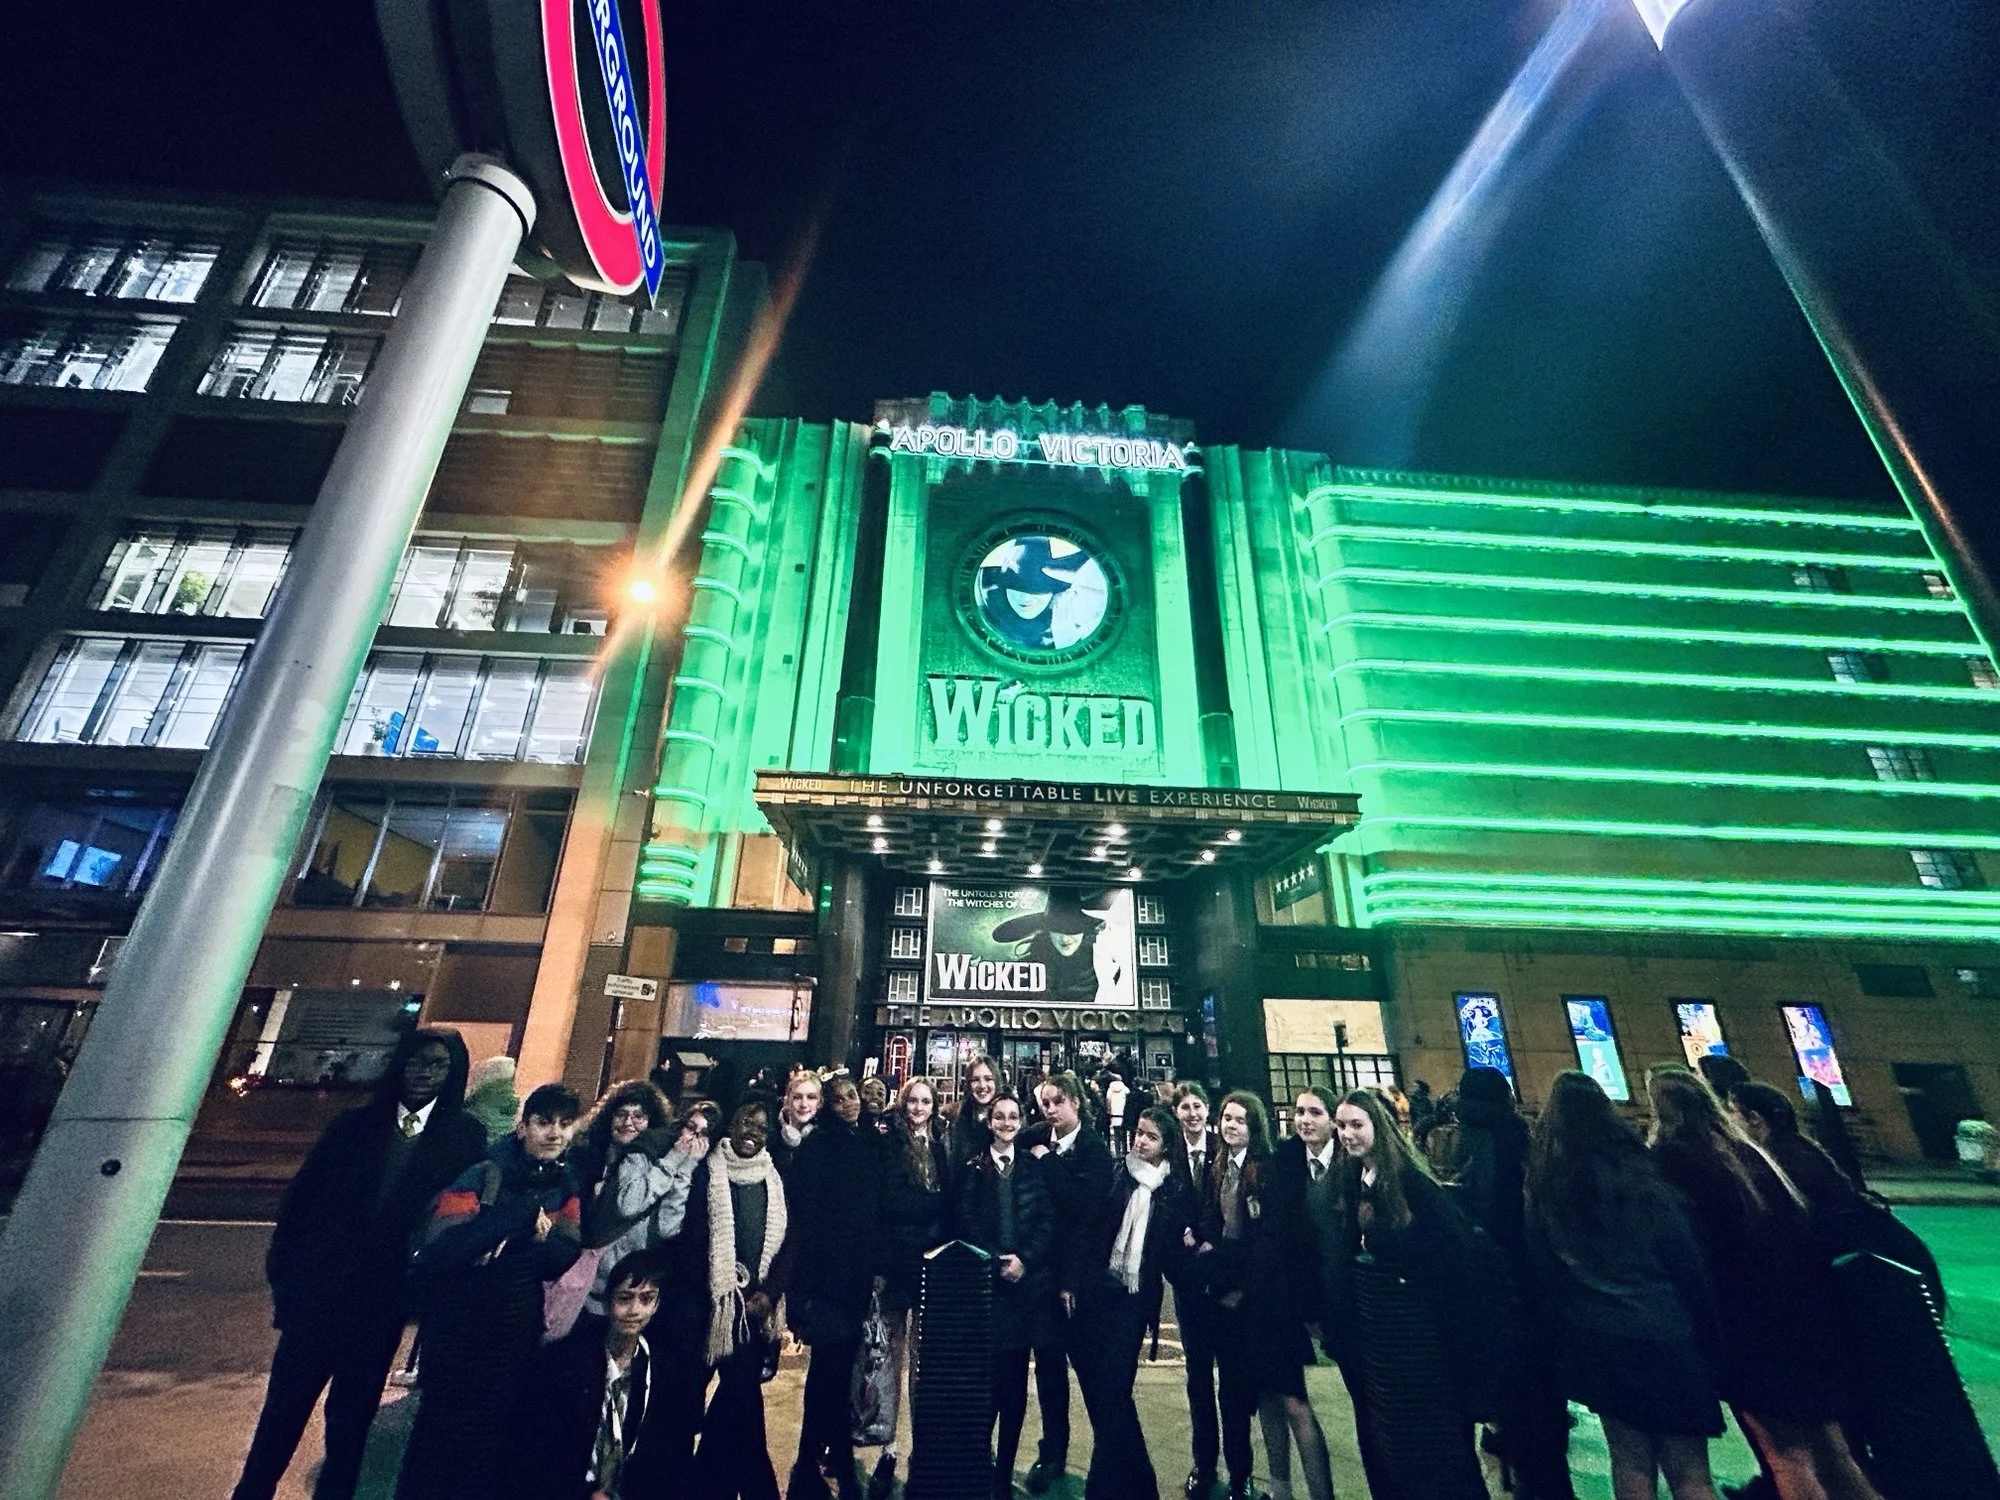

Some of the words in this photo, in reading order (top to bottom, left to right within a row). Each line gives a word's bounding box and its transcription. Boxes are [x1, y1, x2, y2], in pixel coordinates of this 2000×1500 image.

[593, 0, 656, 269] RGROUND
[891, 427, 1016, 460] APOLLO
[1038, 433, 1186, 470] VICTORIA
[850, 780, 888, 793] THE
[899, 780, 1082, 801] UNFORGETTABLE
[1094, 788, 1138, 803] LIVE
[1150, 790, 1277, 808] EXPERIENCE
[942, 887, 960, 897] THE
[961, 889, 997, 898] UNTOLD
[998, 890, 1024, 899] STORY
[946, 898, 964, 907] THE
[965, 899, 1004, 908] WITCHES
[887, 1005, 931, 1026] THE
[942, 1007, 1042, 1029] APOLLO
[1052, 1009, 1176, 1033] VICTOA
